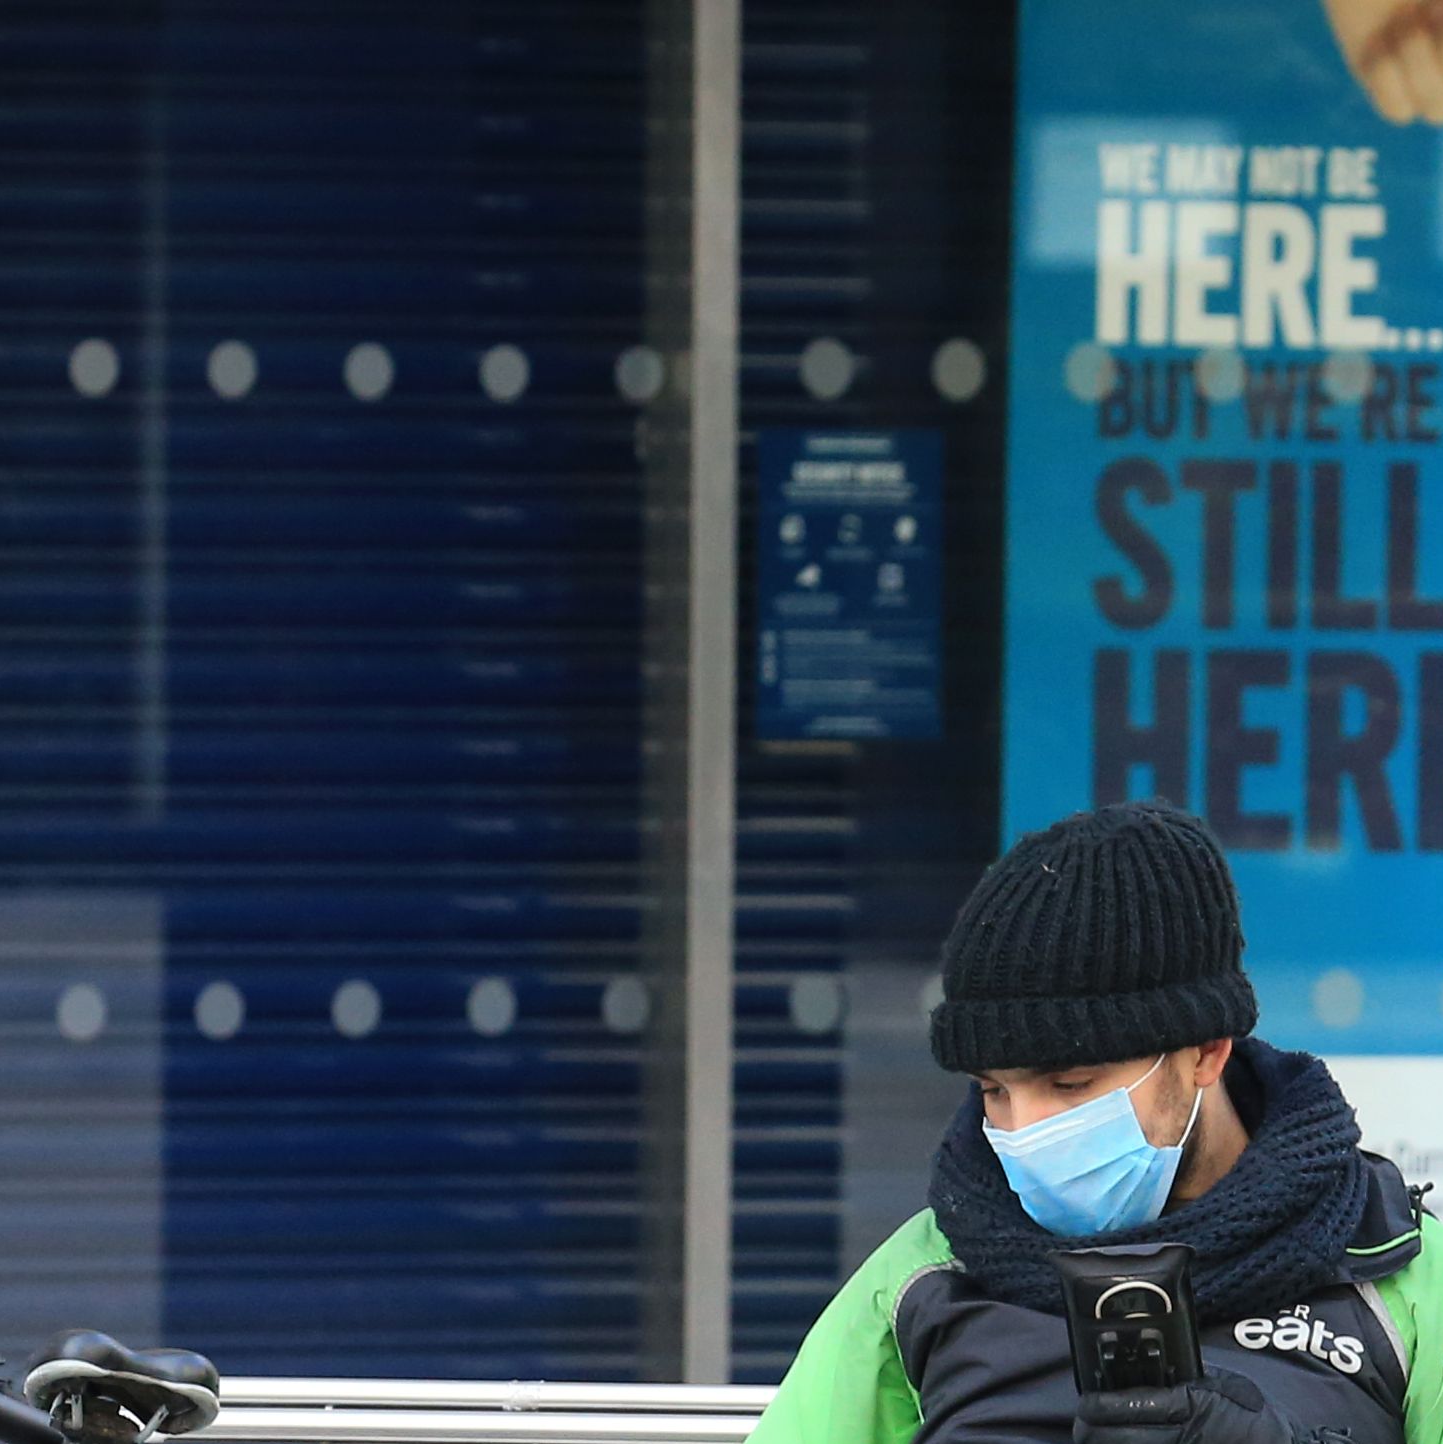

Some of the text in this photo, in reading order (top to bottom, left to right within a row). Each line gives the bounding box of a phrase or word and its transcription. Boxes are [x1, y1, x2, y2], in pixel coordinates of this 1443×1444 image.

[1099, 143, 1379, 198] WE MAY NOT BE
[1099, 358, 1443, 443] BUT WERE
[1233, 1313, 1365, 1375] eats
